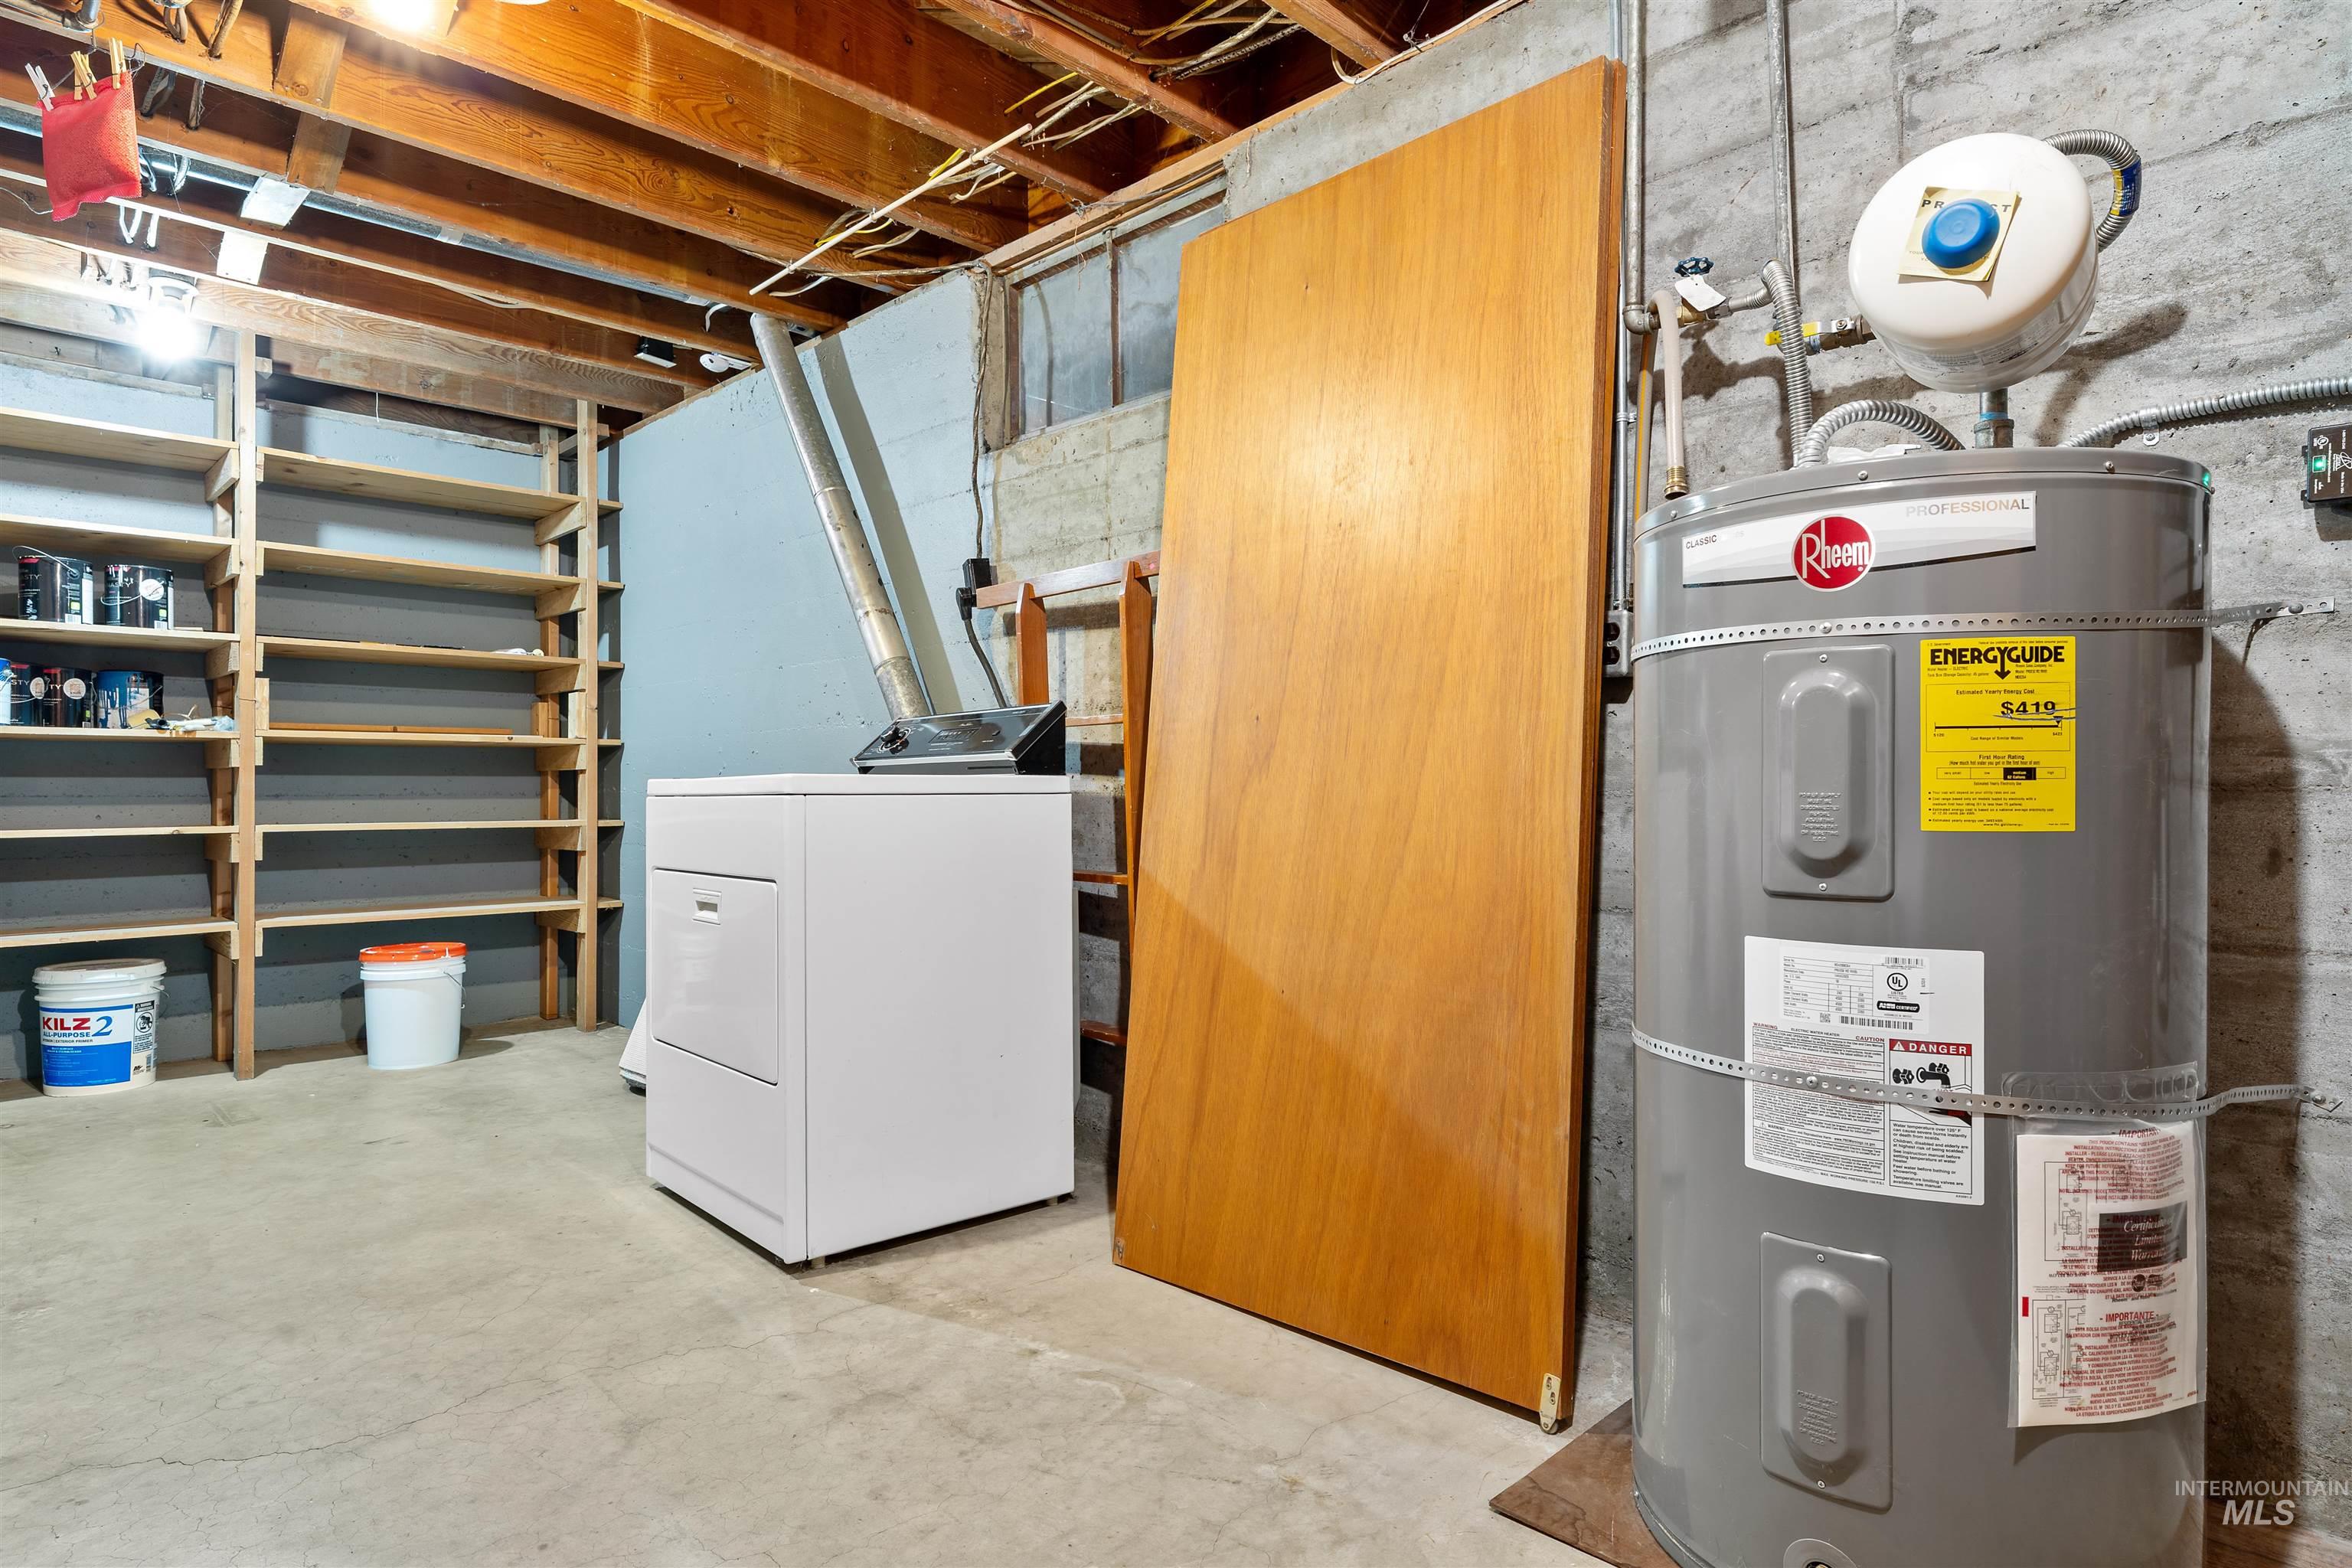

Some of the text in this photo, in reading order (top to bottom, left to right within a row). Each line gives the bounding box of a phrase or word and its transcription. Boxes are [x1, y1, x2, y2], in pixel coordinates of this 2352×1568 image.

[1906, 498, 2030, 518] PROFESSIONAL
[1685, 534, 1717, 549] CLASSIC
[1802, 519, 1870, 580] Rheem
[1931, 646, 2064, 668] ENERGYGUIDE
[2000, 701, 2055, 715] $419
[1892, 977, 1903, 987] UL
[43, 1016, 113, 1037] KILZ 2
[1910, 1043, 1966, 1054] DANGER
[2106, 1311, 2154, 1322] IMPORTANTE
